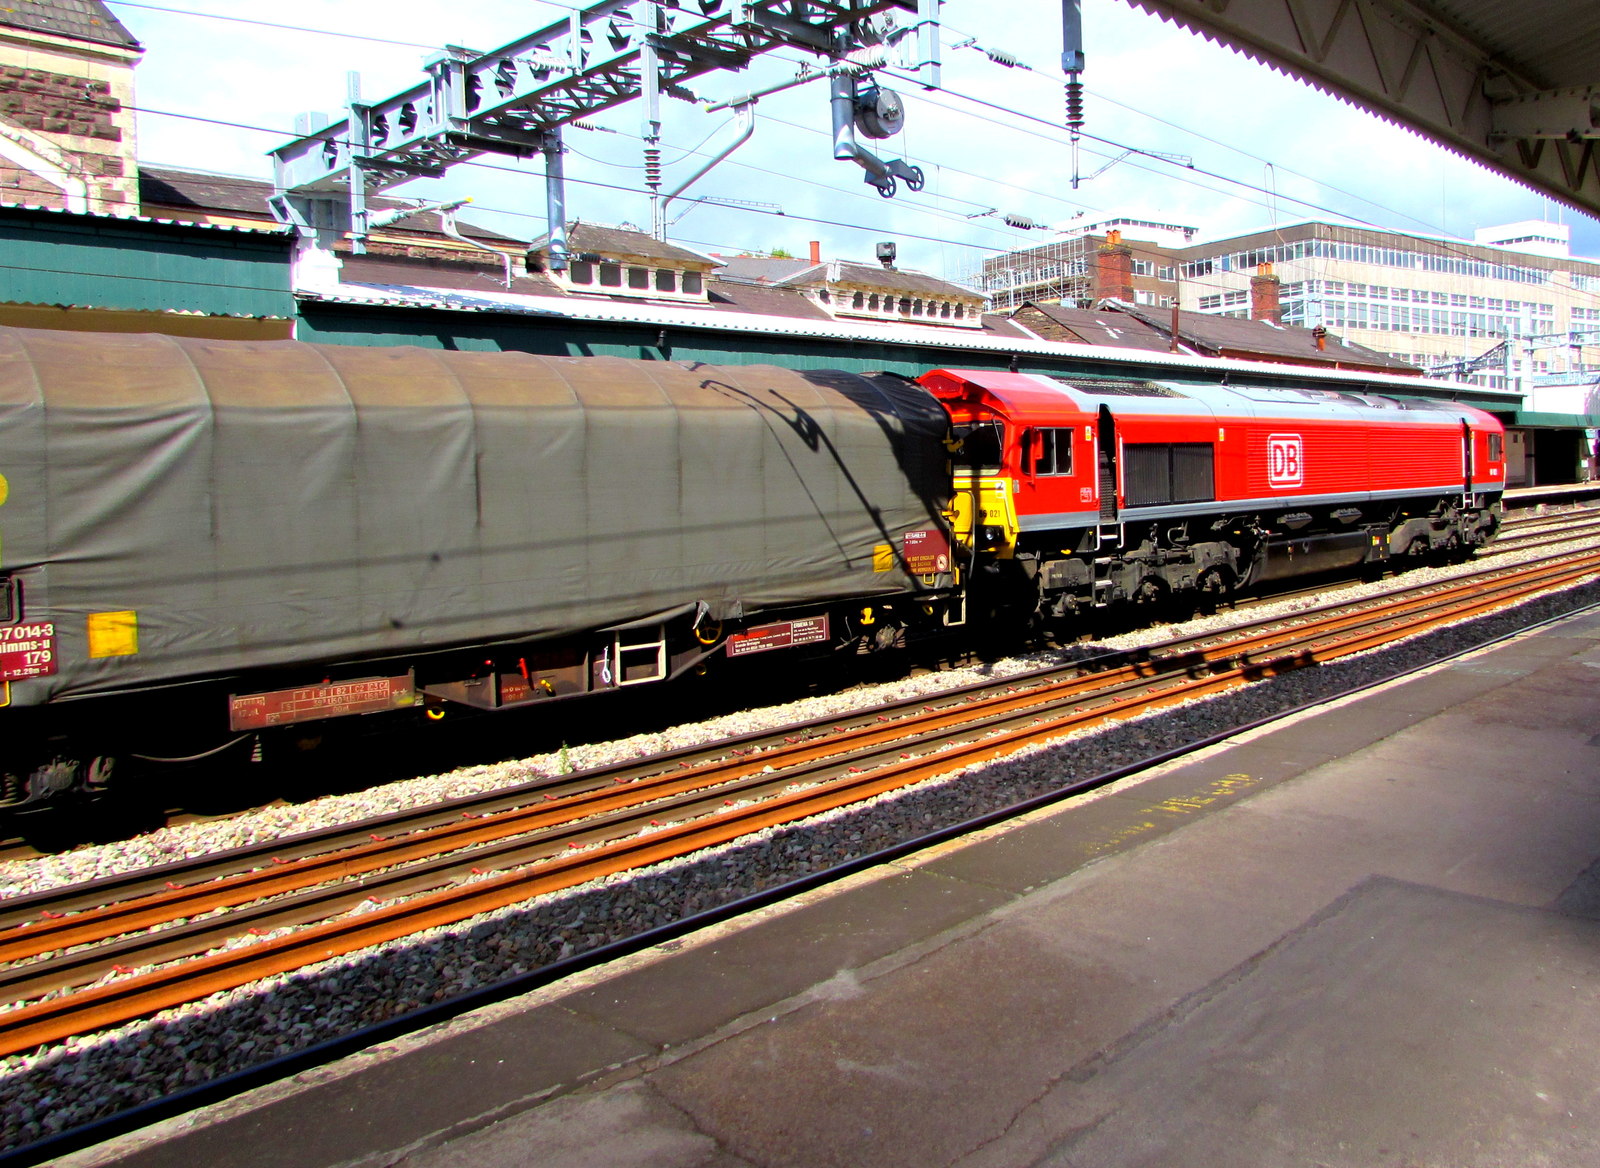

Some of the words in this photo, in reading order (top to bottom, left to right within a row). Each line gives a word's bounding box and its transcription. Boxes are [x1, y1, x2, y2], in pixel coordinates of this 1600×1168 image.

[1273, 444, 1298, 477] DB
[989, 509, 1001, 518] 021
[0, 627, 13, 641] 7
[14, 623, 54, 640] 014-3
[24, 650, 52, 665] 179
[336, 687, 347, 695] B2
[355, 685, 364, 693] C2
